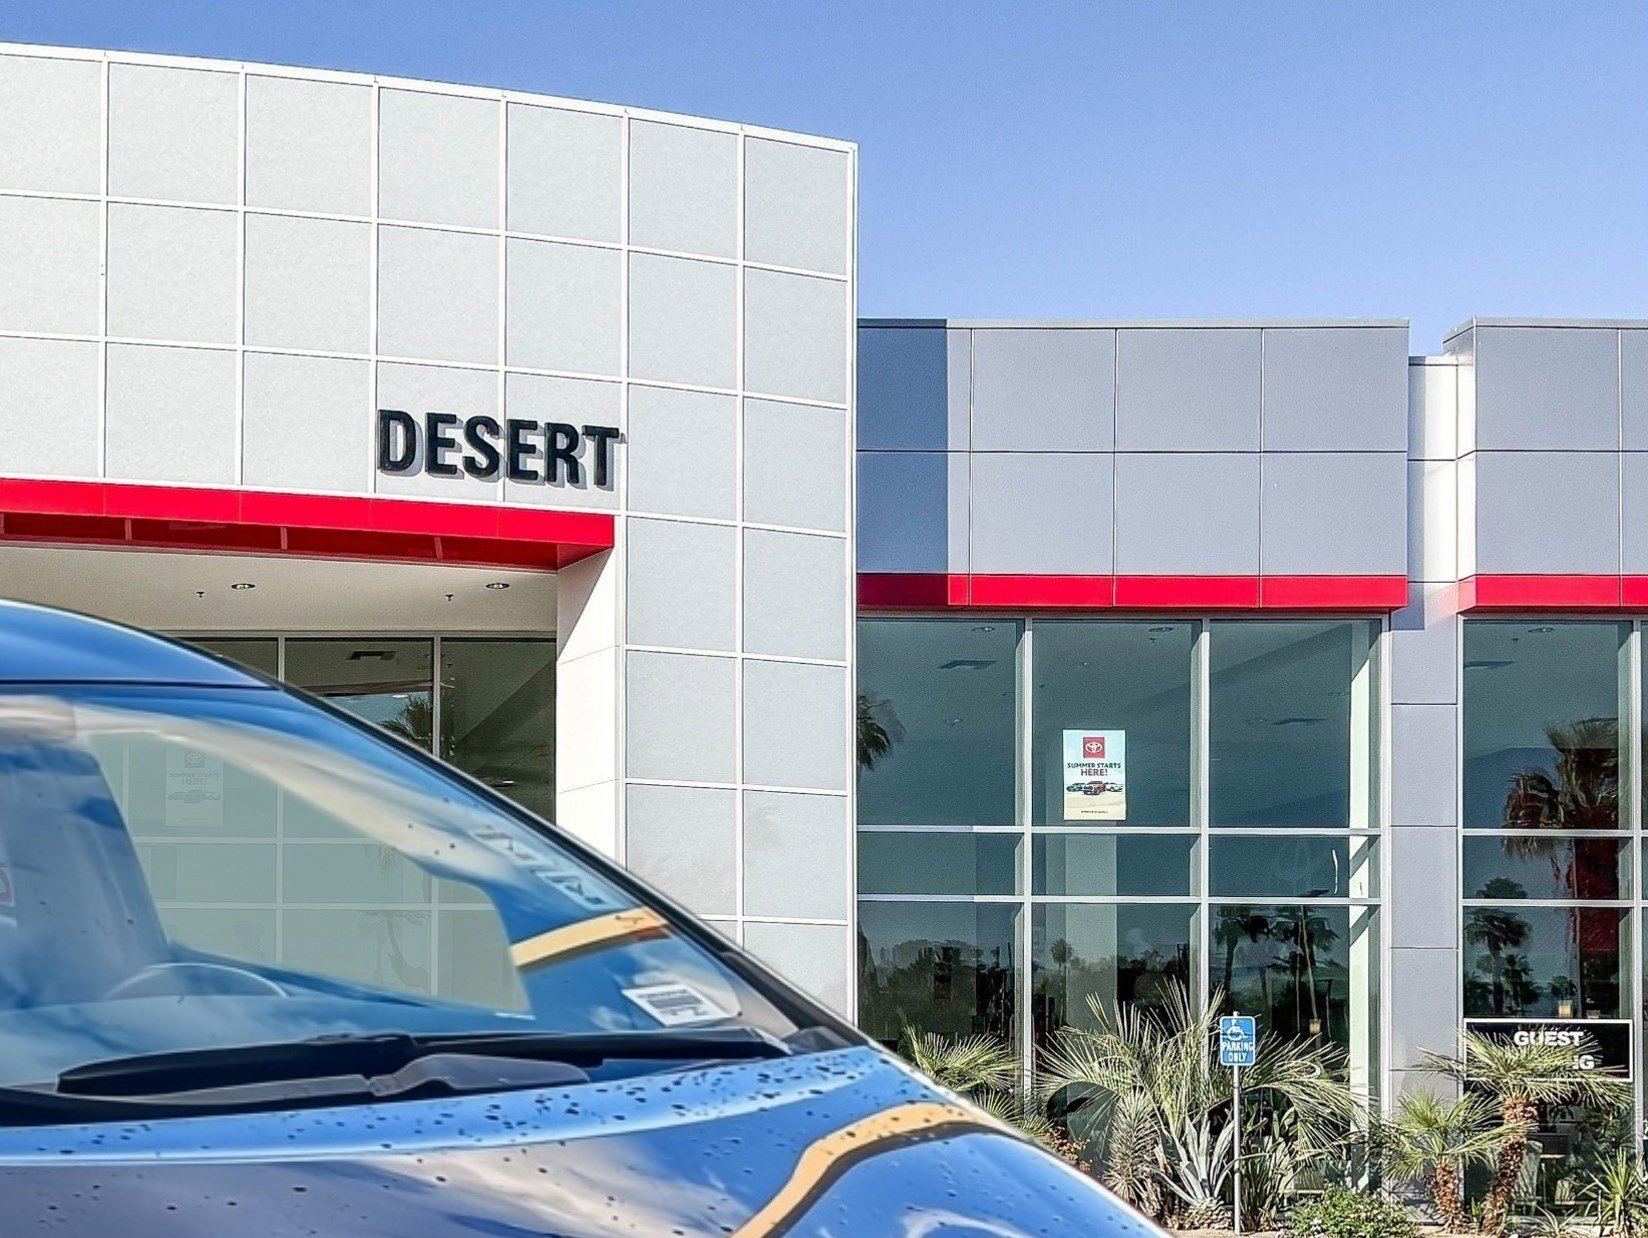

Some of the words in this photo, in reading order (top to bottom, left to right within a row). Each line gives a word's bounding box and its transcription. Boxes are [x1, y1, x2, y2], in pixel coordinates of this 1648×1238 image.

[376, 409, 620, 487] DESERT
[1513, 1030, 1585, 1047] GUEST
[1222, 1041, 1253, 1051] PARKING
[1228, 1052, 1248, 1062] ONLY
